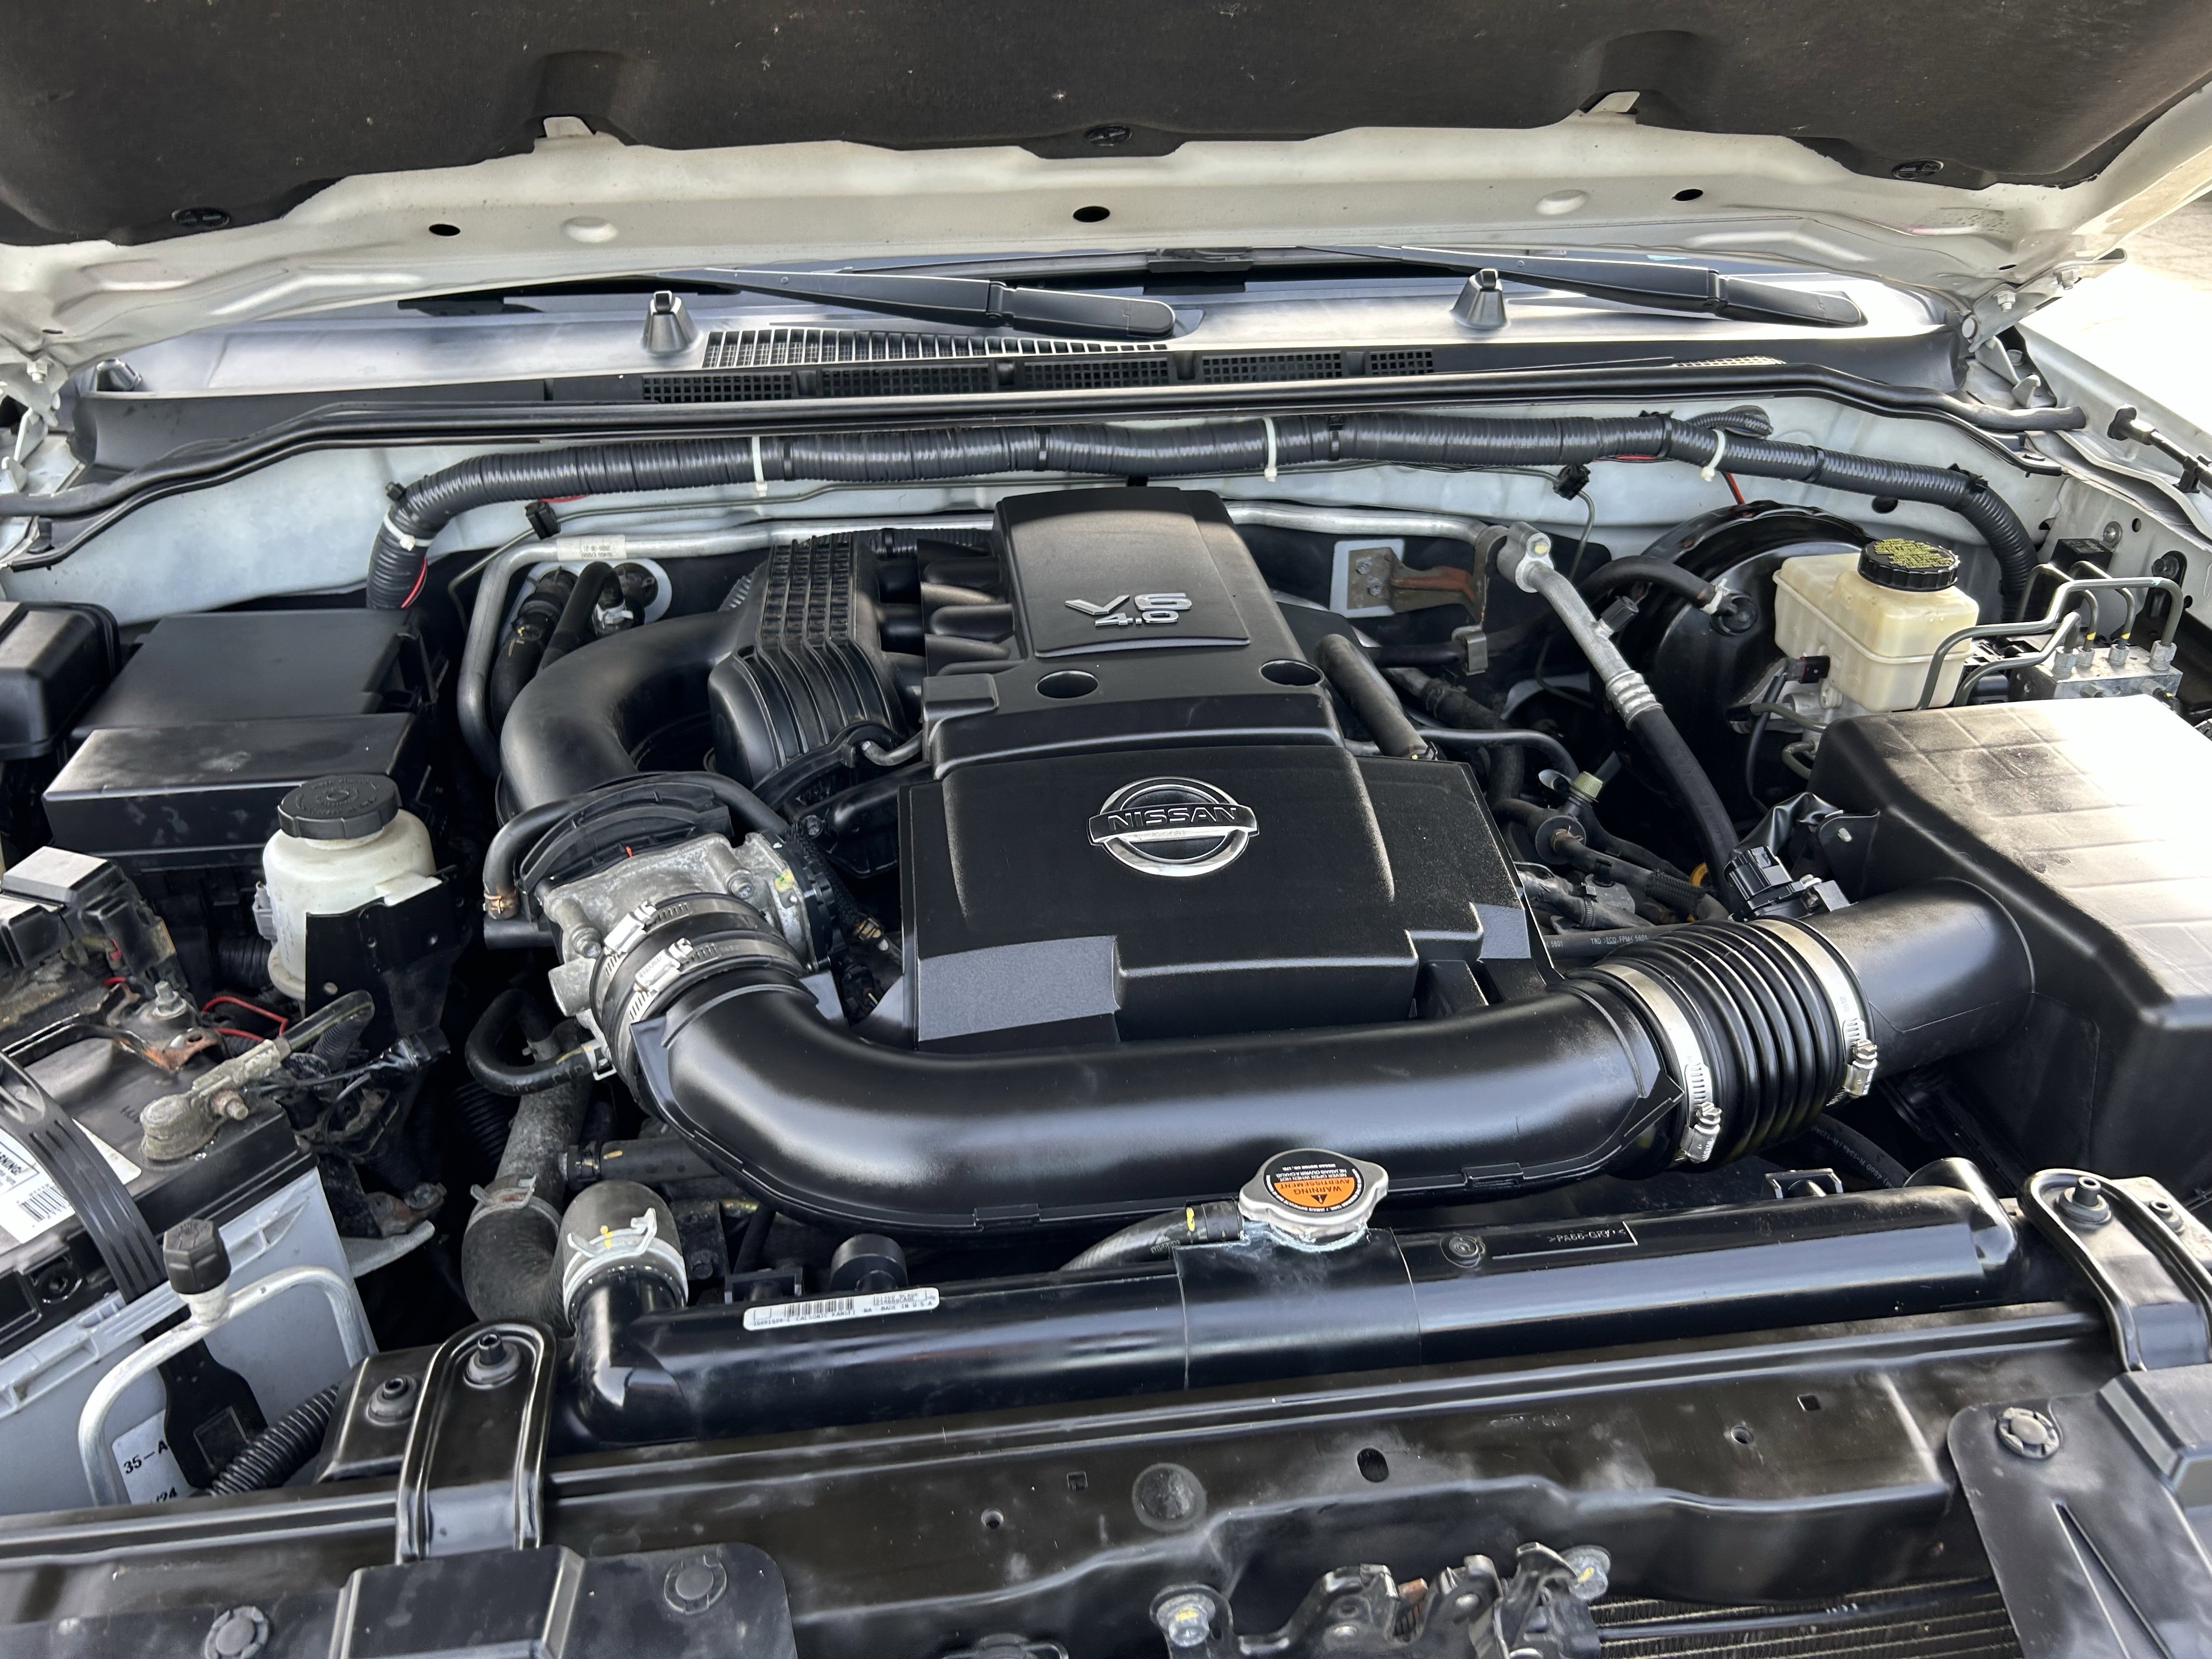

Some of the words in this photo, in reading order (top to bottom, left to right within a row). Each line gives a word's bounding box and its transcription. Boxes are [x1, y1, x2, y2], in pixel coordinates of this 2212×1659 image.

[1065, 593, 1192, 615] V6
[1095, 610, 1179, 627] 4.0
[1108, 806, 1237, 831] NISSAN
[1280, 1179, 1350, 1189] AVERTISSEMENT
[1294, 1186, 1342, 1195] WARNING
